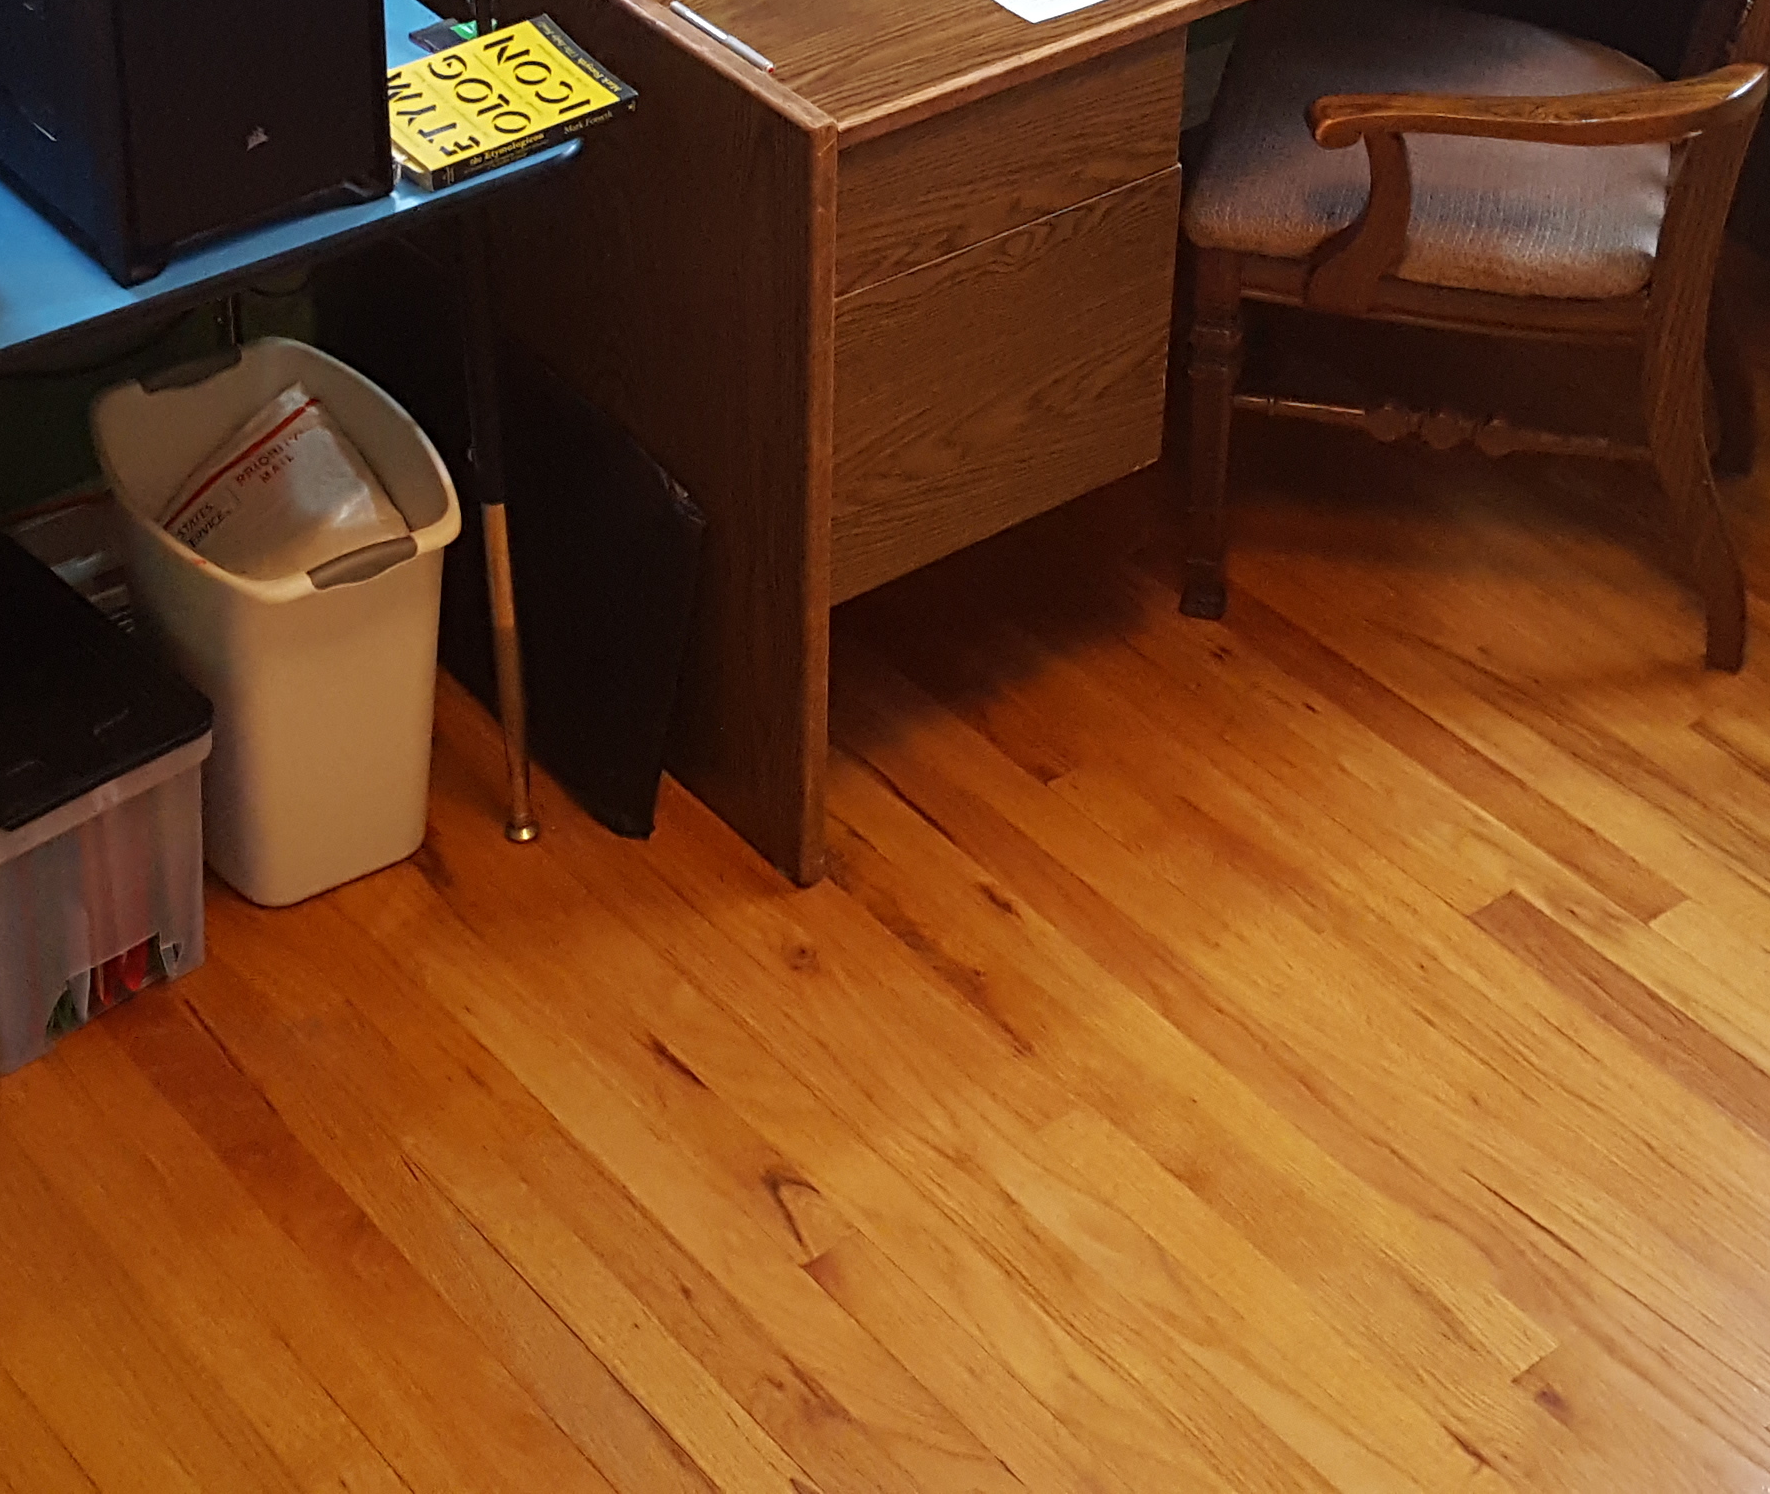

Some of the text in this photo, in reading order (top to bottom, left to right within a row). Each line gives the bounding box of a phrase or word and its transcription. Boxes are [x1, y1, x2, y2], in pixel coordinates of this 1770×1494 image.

[427, 54, 532, 134] OLOG
[483, 34, 591, 115] ICON
[259, 454, 295, 484] MAIL
[186, 512, 226, 549] ERVICE
